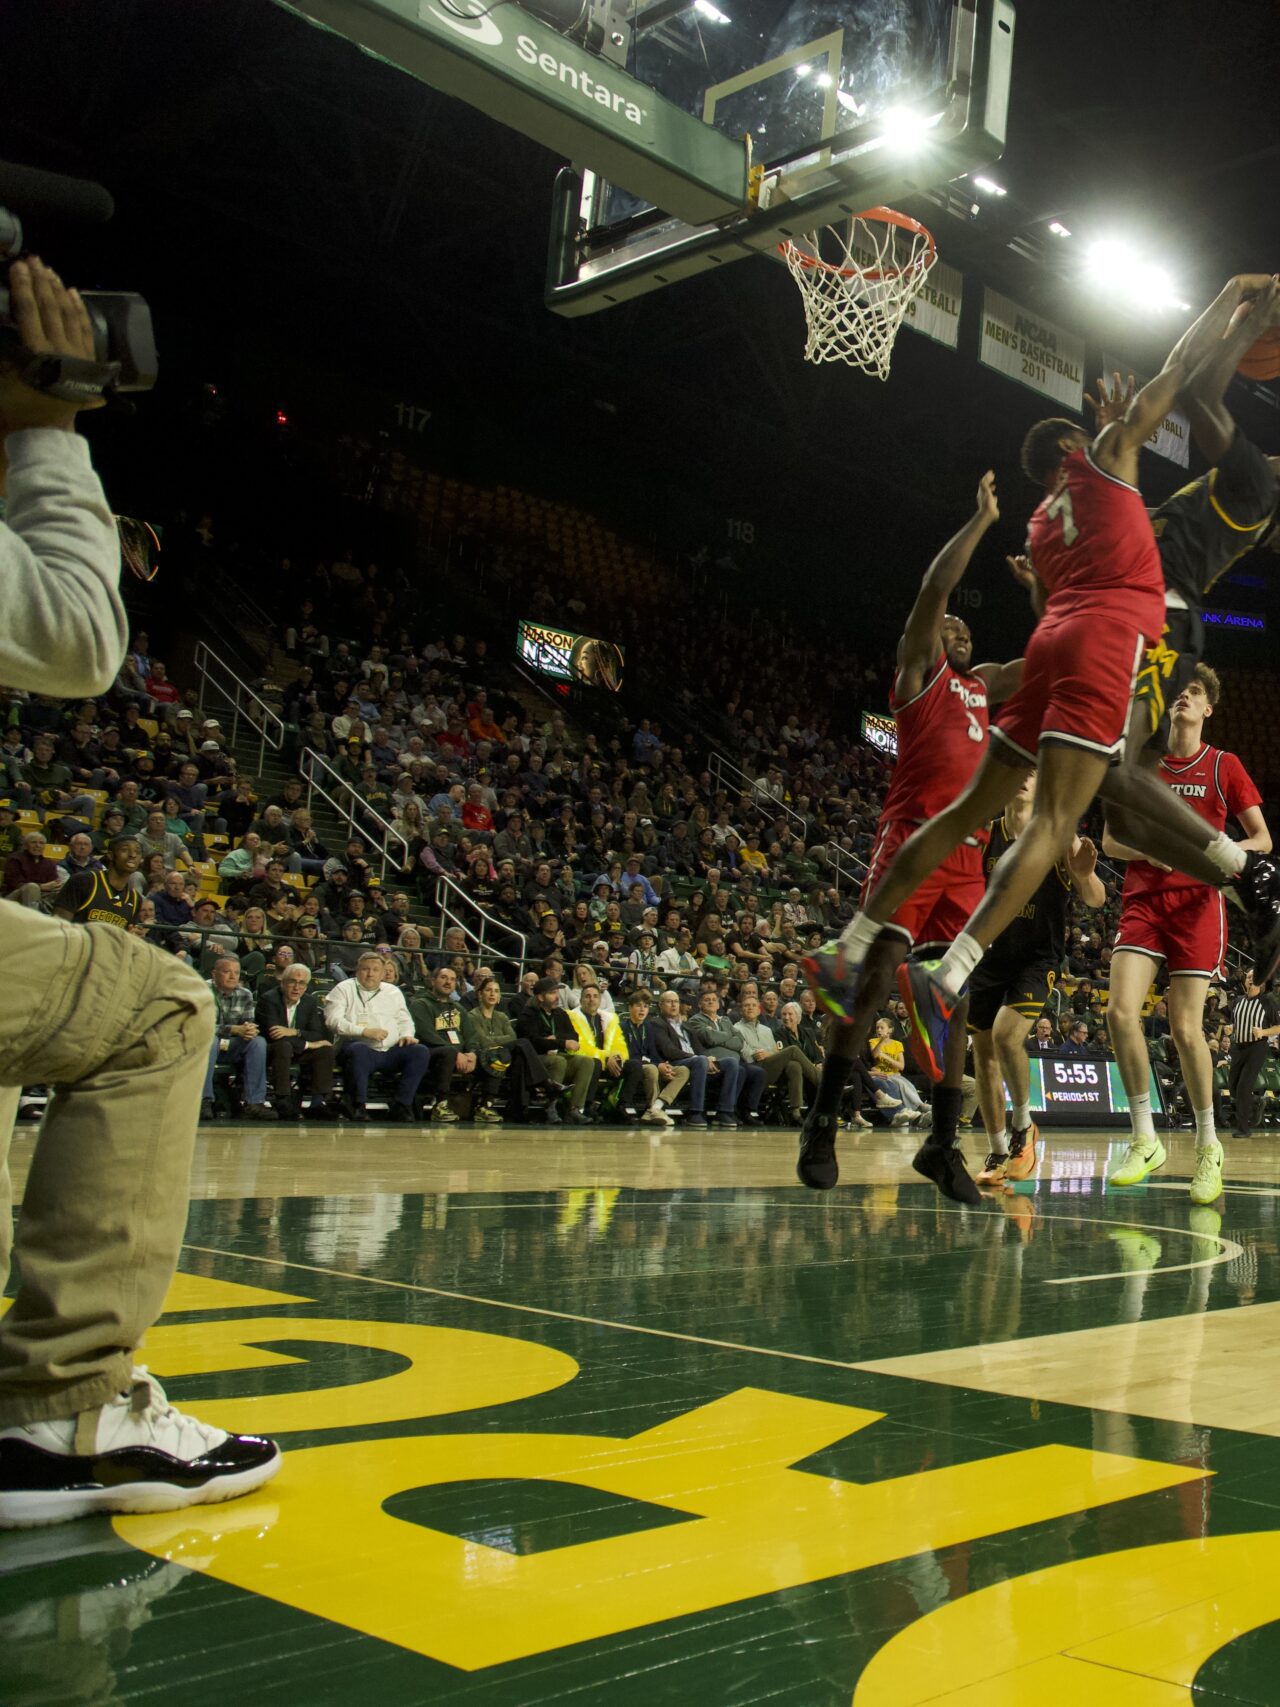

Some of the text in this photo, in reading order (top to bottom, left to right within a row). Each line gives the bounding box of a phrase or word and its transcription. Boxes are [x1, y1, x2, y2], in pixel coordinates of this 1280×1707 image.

[516, 34, 641, 125] Sentara
[985, 319, 1080, 384] MEN'S BASKETBALL
[1022, 358, 1046, 385] 2011
[395, 402, 432, 434] 117
[725, 518, 755, 544] 118
[1223, 613, 1265, 629] ARENA
[1171, 784, 1207, 798] TON
[1054, 1062, 1099, 1085] 5:55
